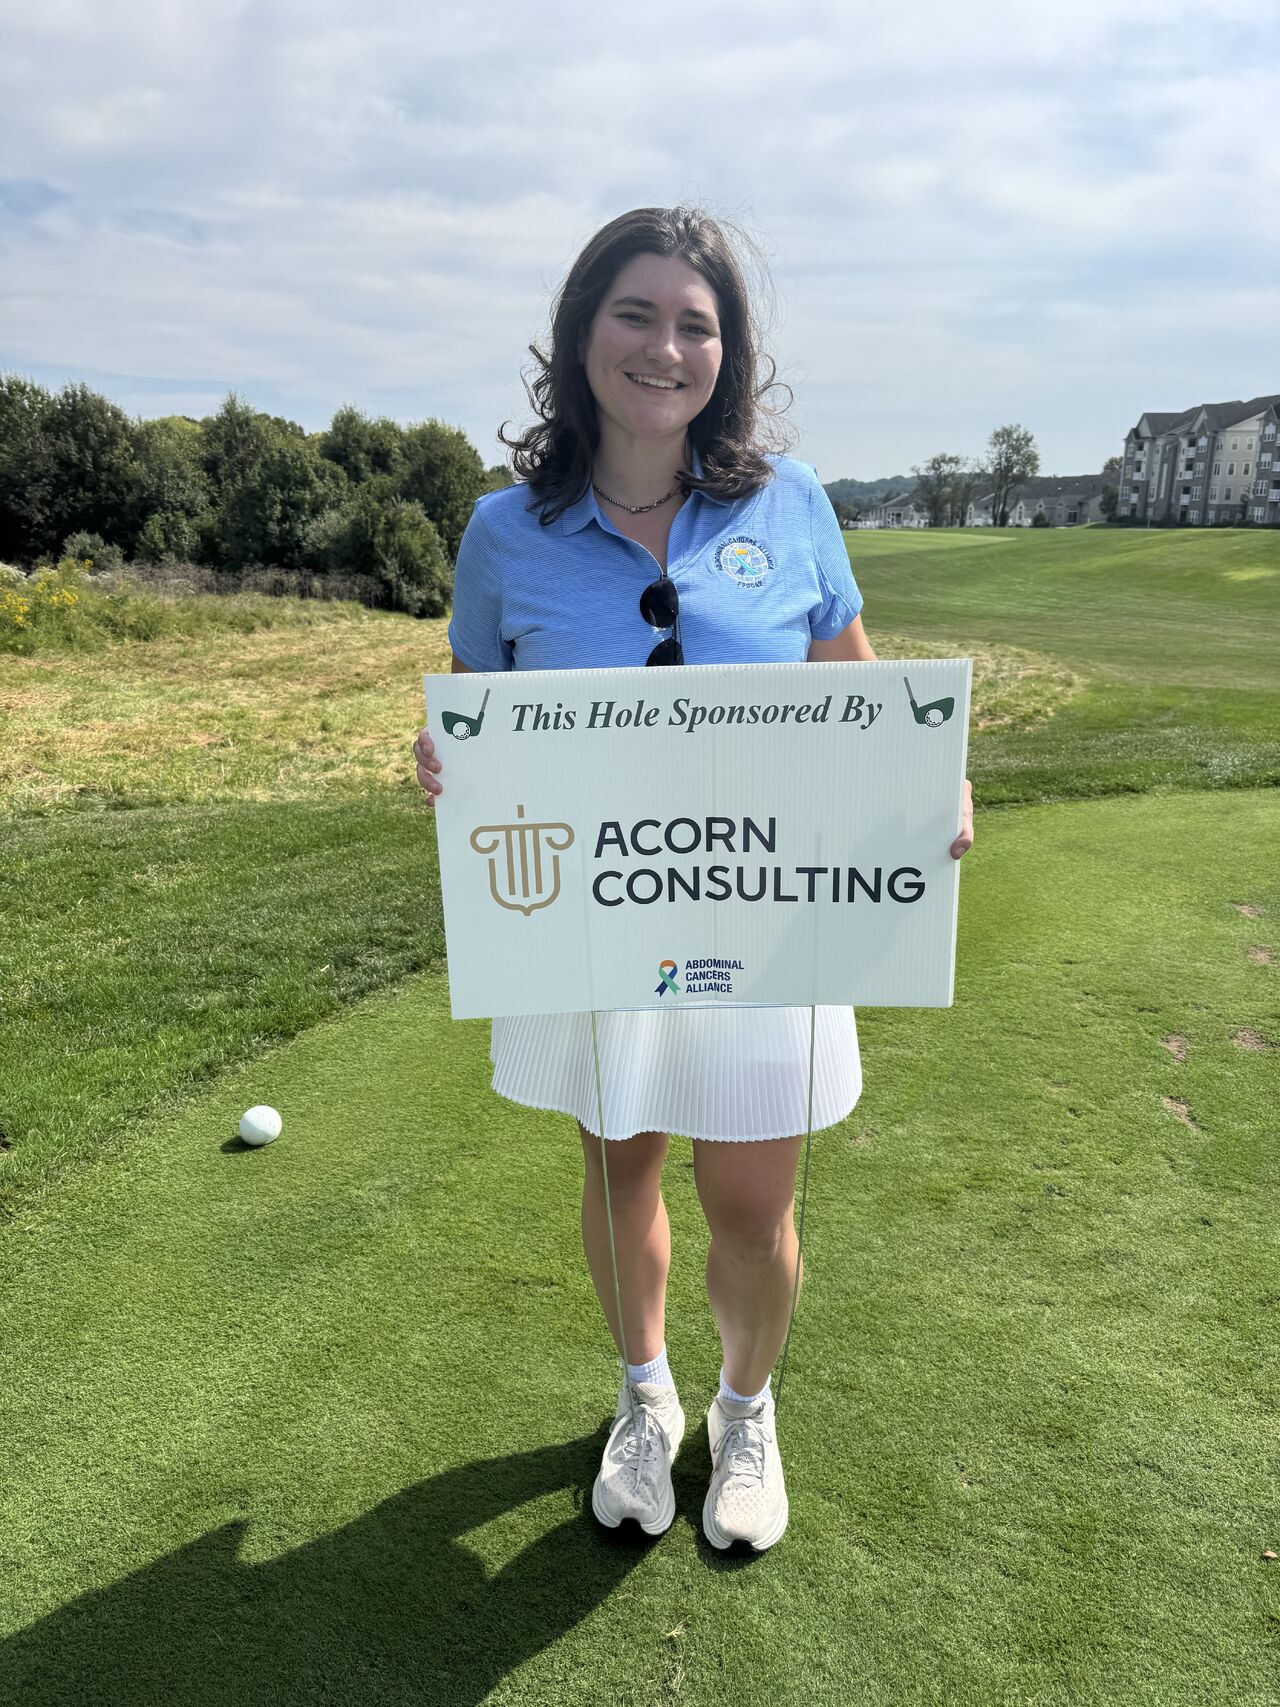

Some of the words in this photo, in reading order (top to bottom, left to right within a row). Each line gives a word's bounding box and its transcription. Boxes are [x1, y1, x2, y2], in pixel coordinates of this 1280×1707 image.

[512, 703, 576, 731] This
[586, 700, 659, 728] Hole
[668, 696, 832, 733] Sponsored
[839, 696, 882, 730] By
[594, 817, 776, 858] ACORN
[593, 866, 925, 906] CONSULTING
[686, 958, 744, 970] ABDOMINAL
[686, 970, 730, 981] CANCERS
[686, 982, 733, 993] ALLIANCE
